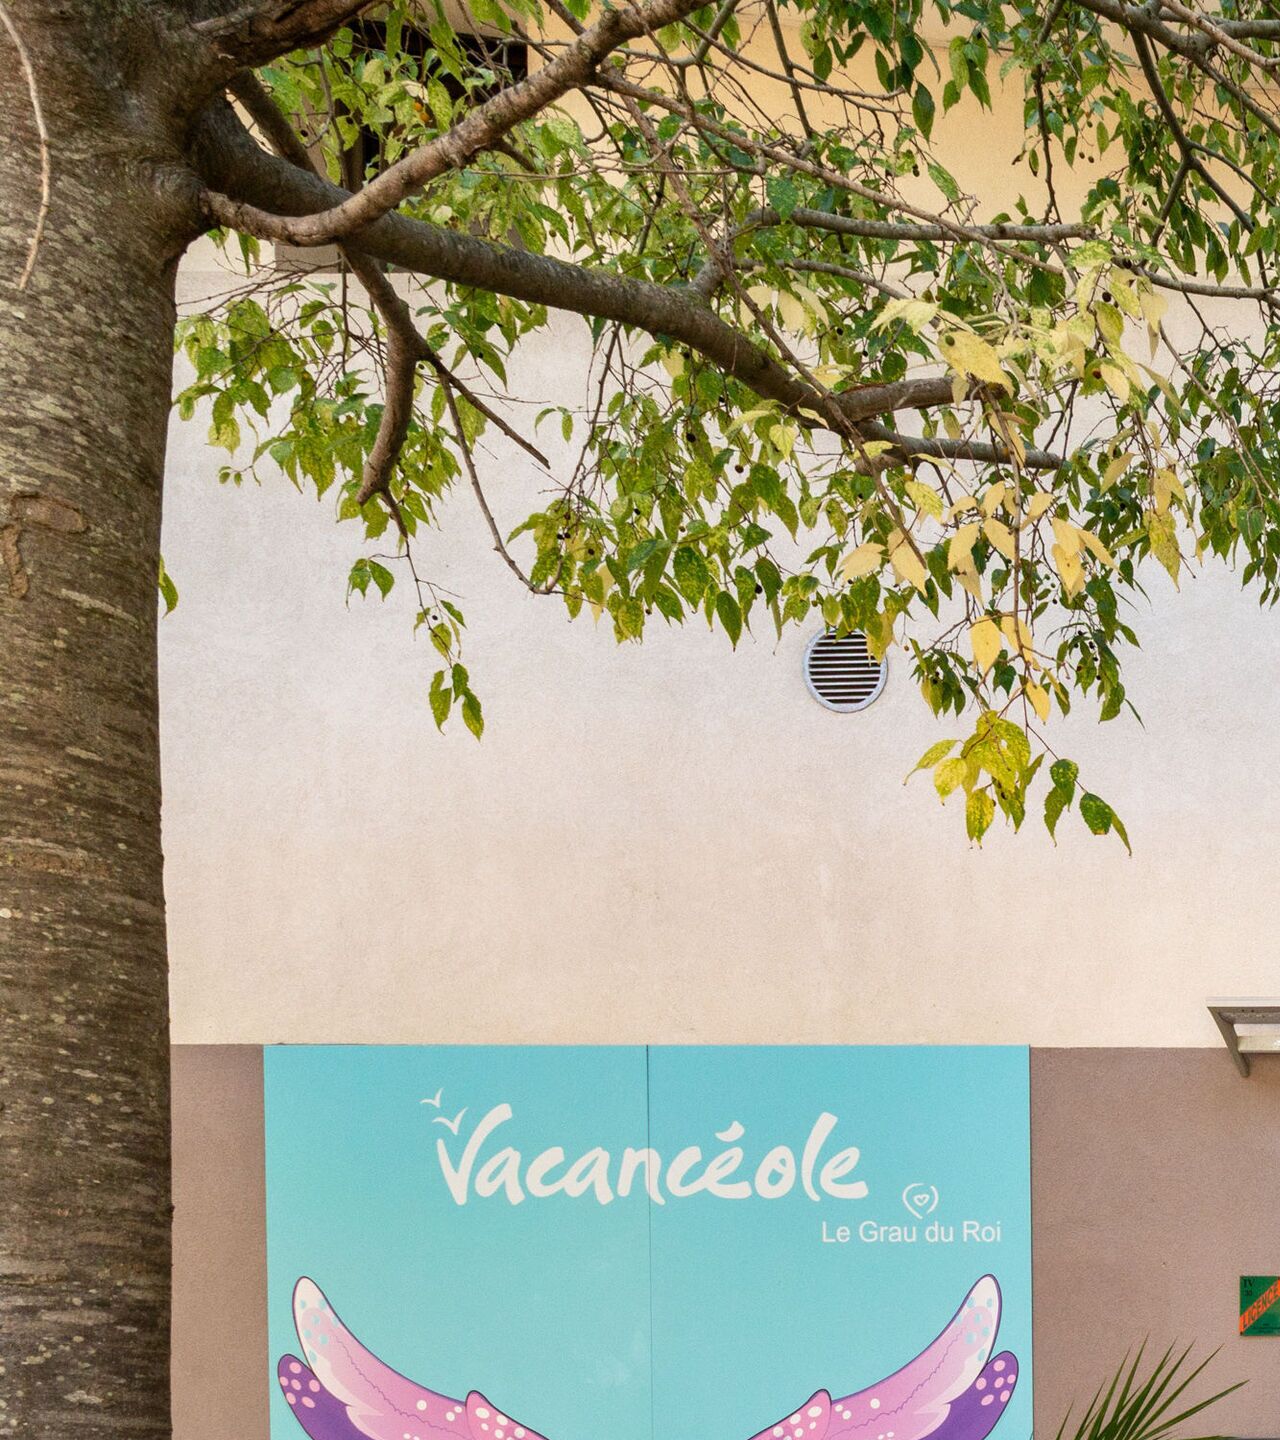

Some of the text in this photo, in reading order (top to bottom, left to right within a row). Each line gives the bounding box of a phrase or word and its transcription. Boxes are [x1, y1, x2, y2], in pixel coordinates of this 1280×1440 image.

[436, 1102, 869, 1206] Vacancéole
[822, 1219, 1002, 1244] Le Grau du Roi
[1240, 1281, 1280, 1332] LICENCE
